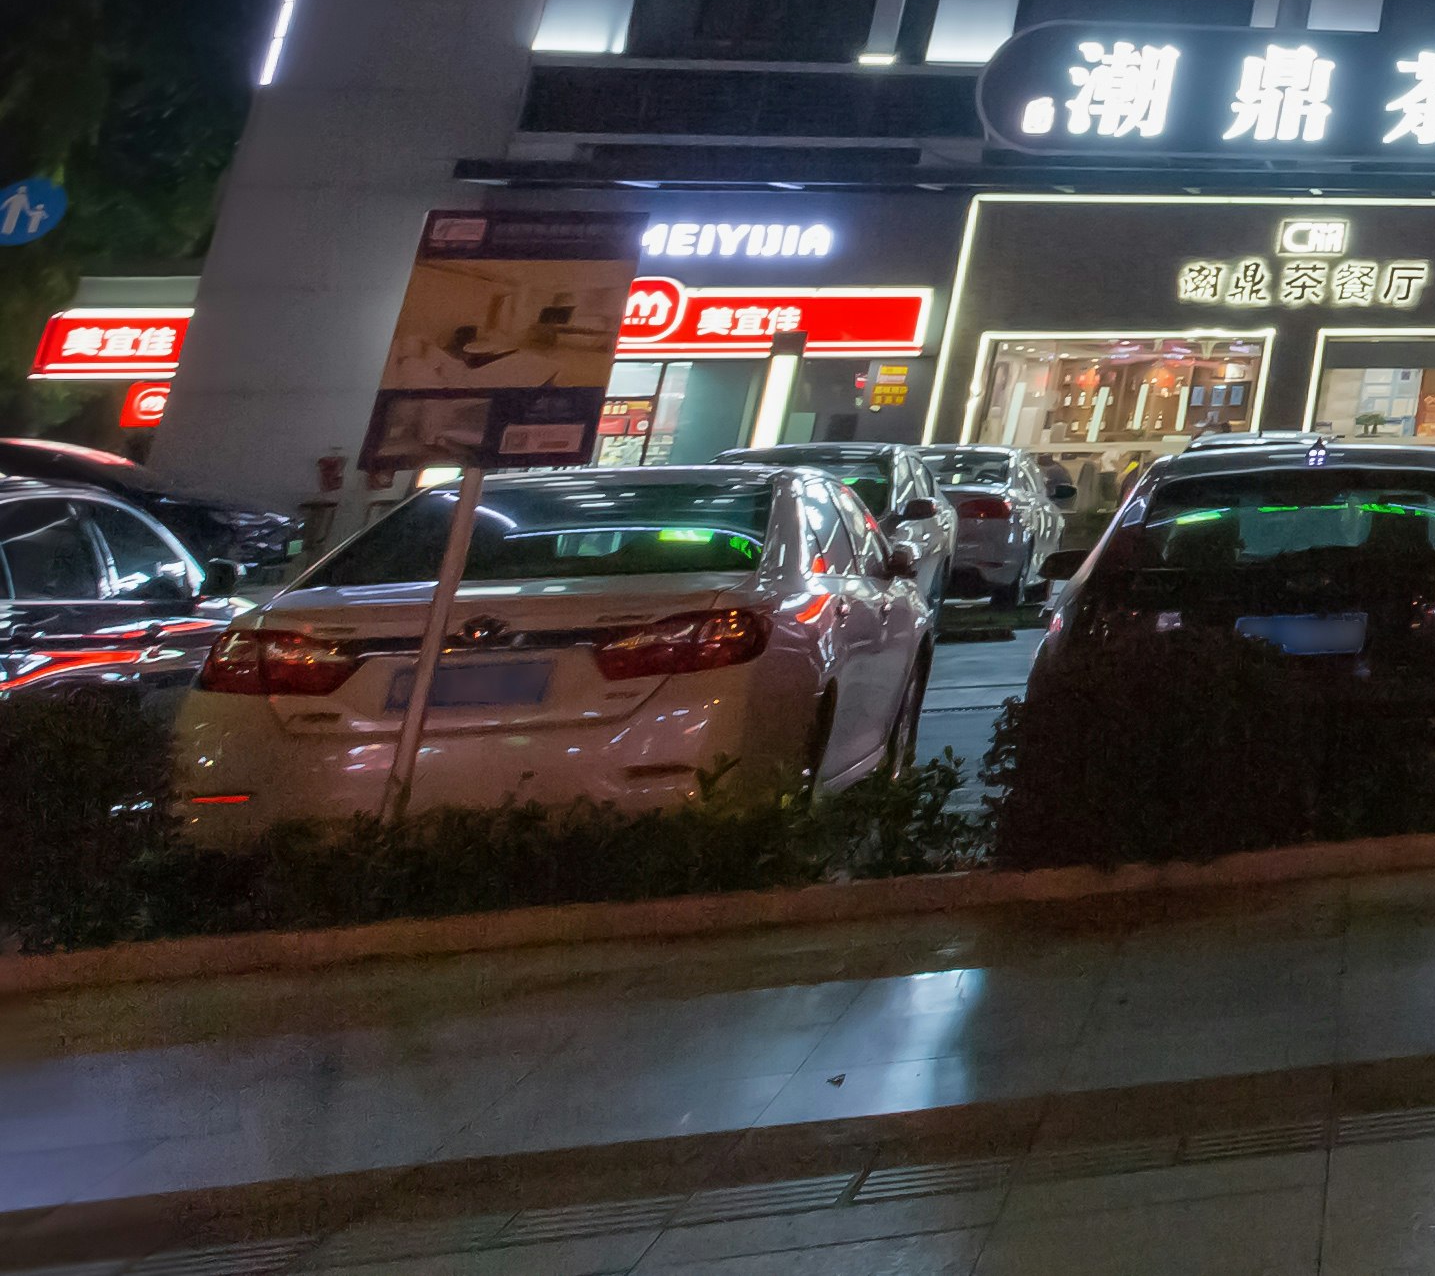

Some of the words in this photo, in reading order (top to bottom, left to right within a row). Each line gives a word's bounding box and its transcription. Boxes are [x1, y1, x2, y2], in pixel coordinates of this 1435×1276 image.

[1183, 260, 1426, 302] 潮鼎茶餐厅
[697, 306, 801, 337] 美宜佳
[61, 326, 177, 357] 美宜佳
